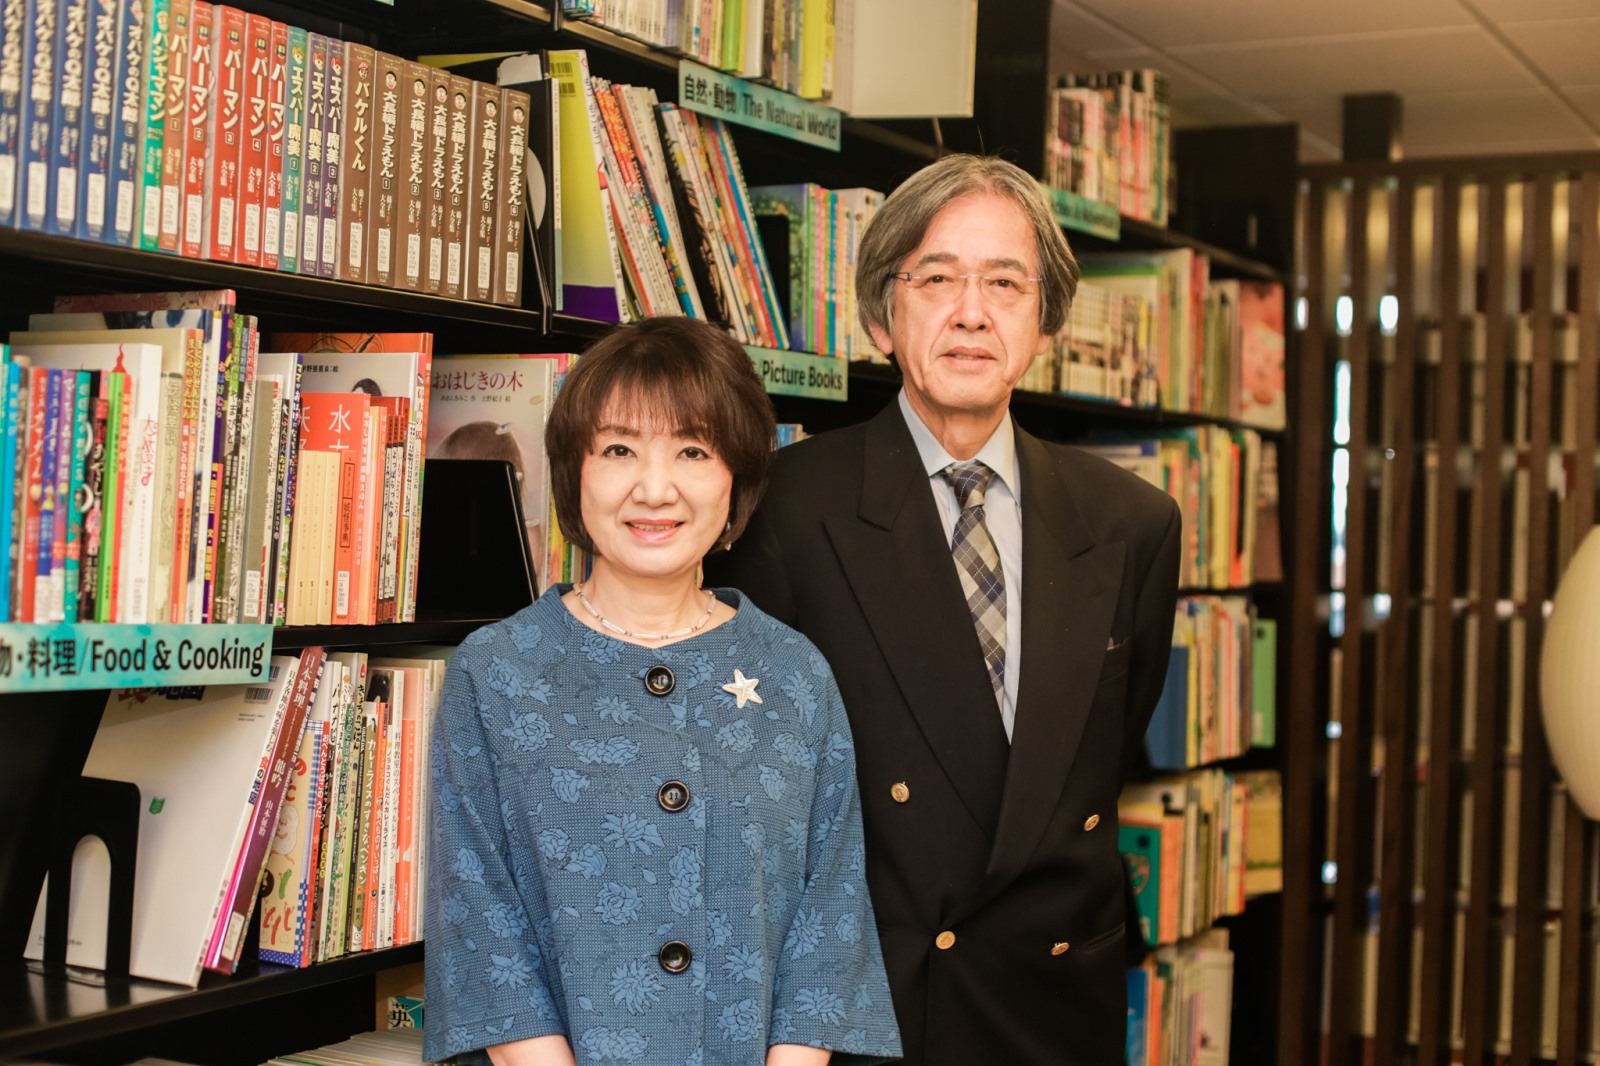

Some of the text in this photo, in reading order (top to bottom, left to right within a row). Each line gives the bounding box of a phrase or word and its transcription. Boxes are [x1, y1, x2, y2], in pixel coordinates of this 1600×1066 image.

[91, 15, 114, 116] オバケのQ太郎
[122, 25, 143, 122] オバケのQ太郎
[168, 33, 188, 116] パーマン
[191, 44, 211, 126] パーマン
[223, 48, 241, 129] パーマン
[250, 57, 269, 136] パーマン
[287, 66, 304, 157] エスパー魔美
[308, 72, 324, 162] エスパー魔美
[326, 76, 342, 165] エスパー魔美
[351, 82, 371, 172] バケルくん
[380, 91, 398, 178] 大長編ドラえもん
[408, 98, 426, 184] 大長編ドラえもん
[431, 105, 448, 189] 大長編ドラえもん
[743, 93, 762, 118] The
[766, 99, 805, 131] Natural
[807, 111, 837, 141] World
[449, 112, 467, 194] 大長編ドラえもん
[480, 119, 498, 200] 大長編ドラえもん
[507, 125, 525, 205] 大長編ドラえもん
[432, 370, 523, 391] おはじきの木
[763, 360, 843, 390] Picture Books
[153, 639, 171, 671] &
[178, 637, 265, 677] Cooking
[294, 654, 316, 709] 日本料理
[358, 740, 376, 885] カレーライスのすきなペンギン
